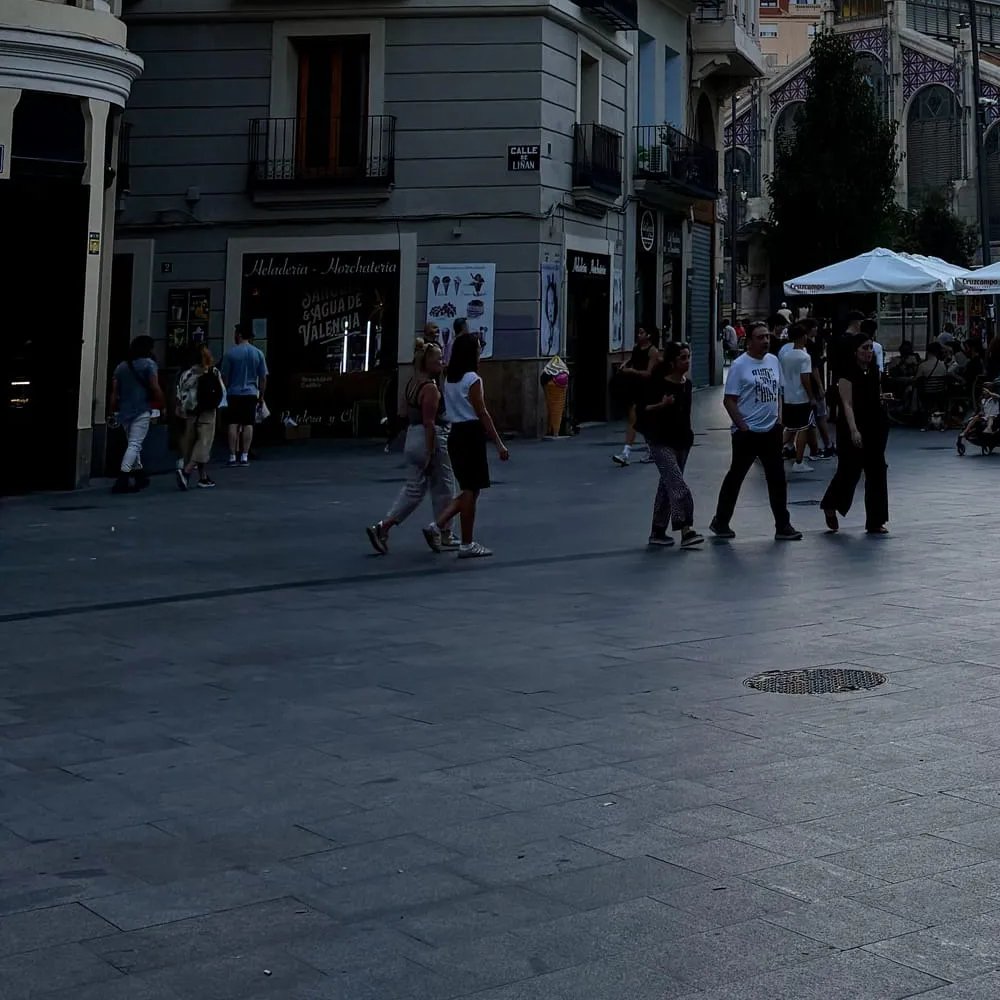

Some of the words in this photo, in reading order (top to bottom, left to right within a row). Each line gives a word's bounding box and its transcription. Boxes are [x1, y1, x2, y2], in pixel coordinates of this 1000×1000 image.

[510, 146, 538, 155] CALLE
[347, 295, 362, 311] DE
[297, 312, 361, 347] VALENCIA
